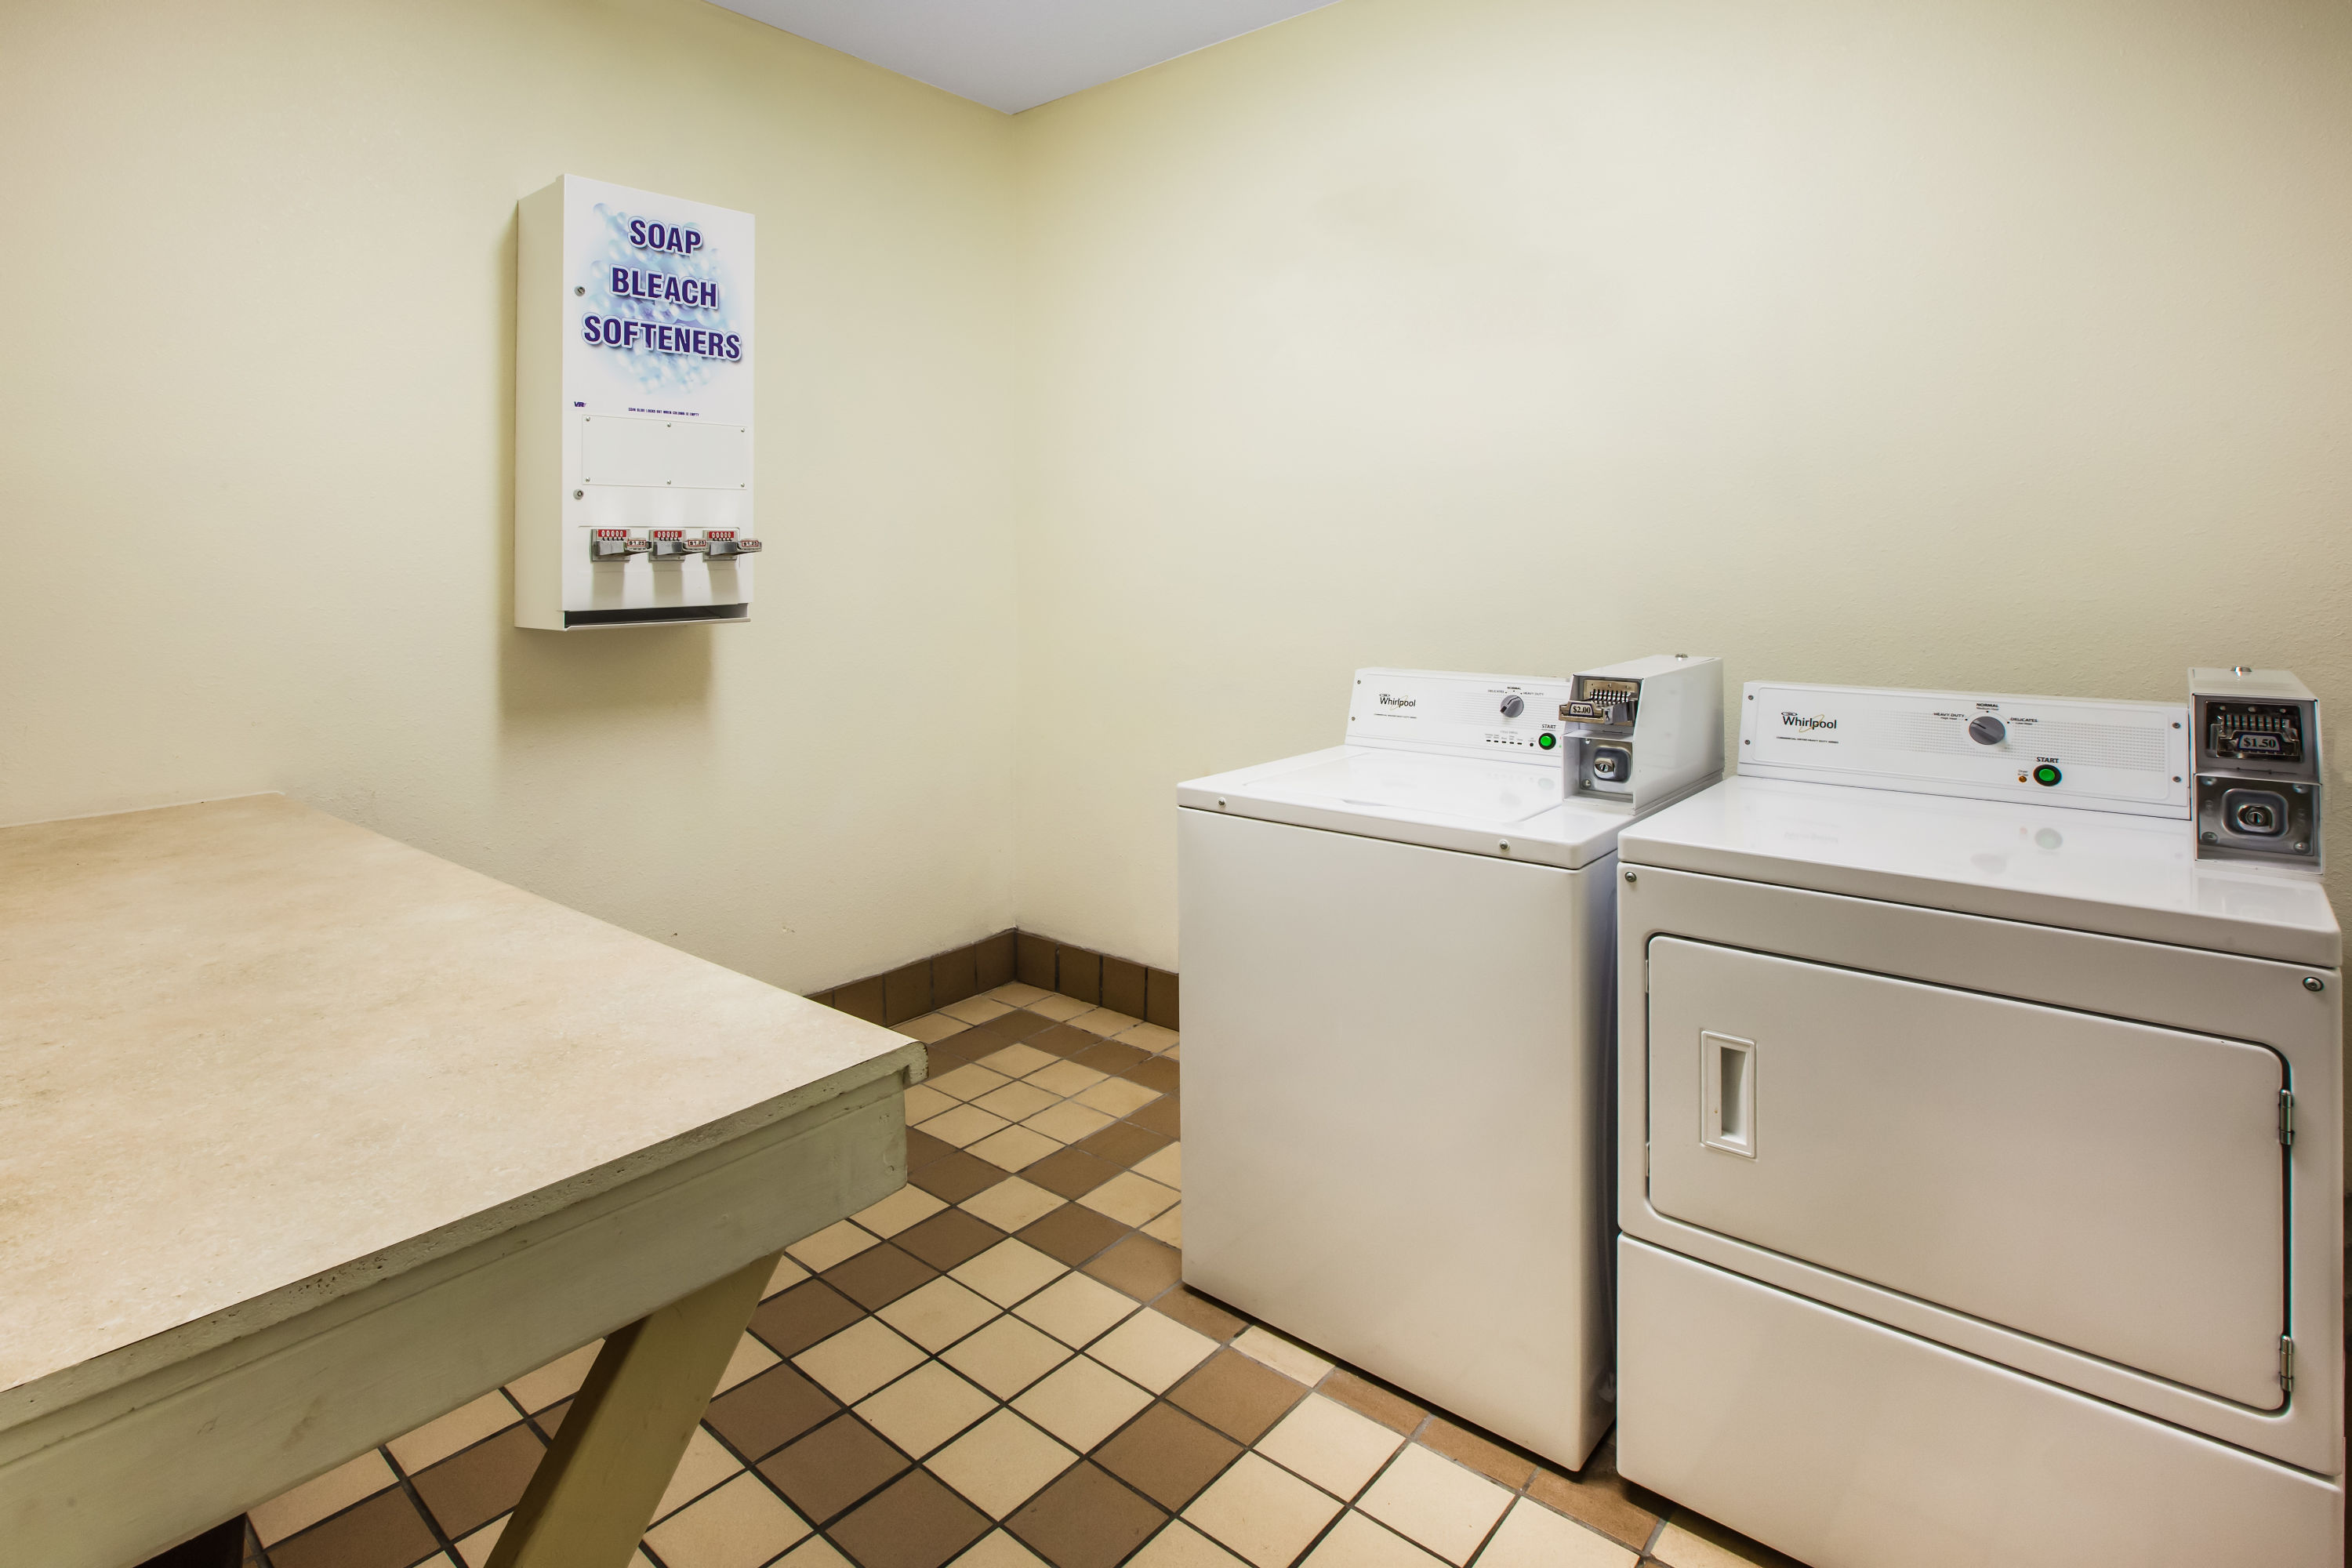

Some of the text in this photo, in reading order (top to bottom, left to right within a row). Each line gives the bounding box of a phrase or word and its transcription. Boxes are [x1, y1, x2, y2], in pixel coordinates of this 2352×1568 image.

[630, 219, 702, 254] SOAP
[612, 266, 717, 307] BLEACH
[583, 314, 740, 359] SOFTENERS
[1380, 696, 1416, 708] Whirlpool
[1783, 716, 1837, 730] Whirlpool
[2244, 737, 2276, 748] $1.50
